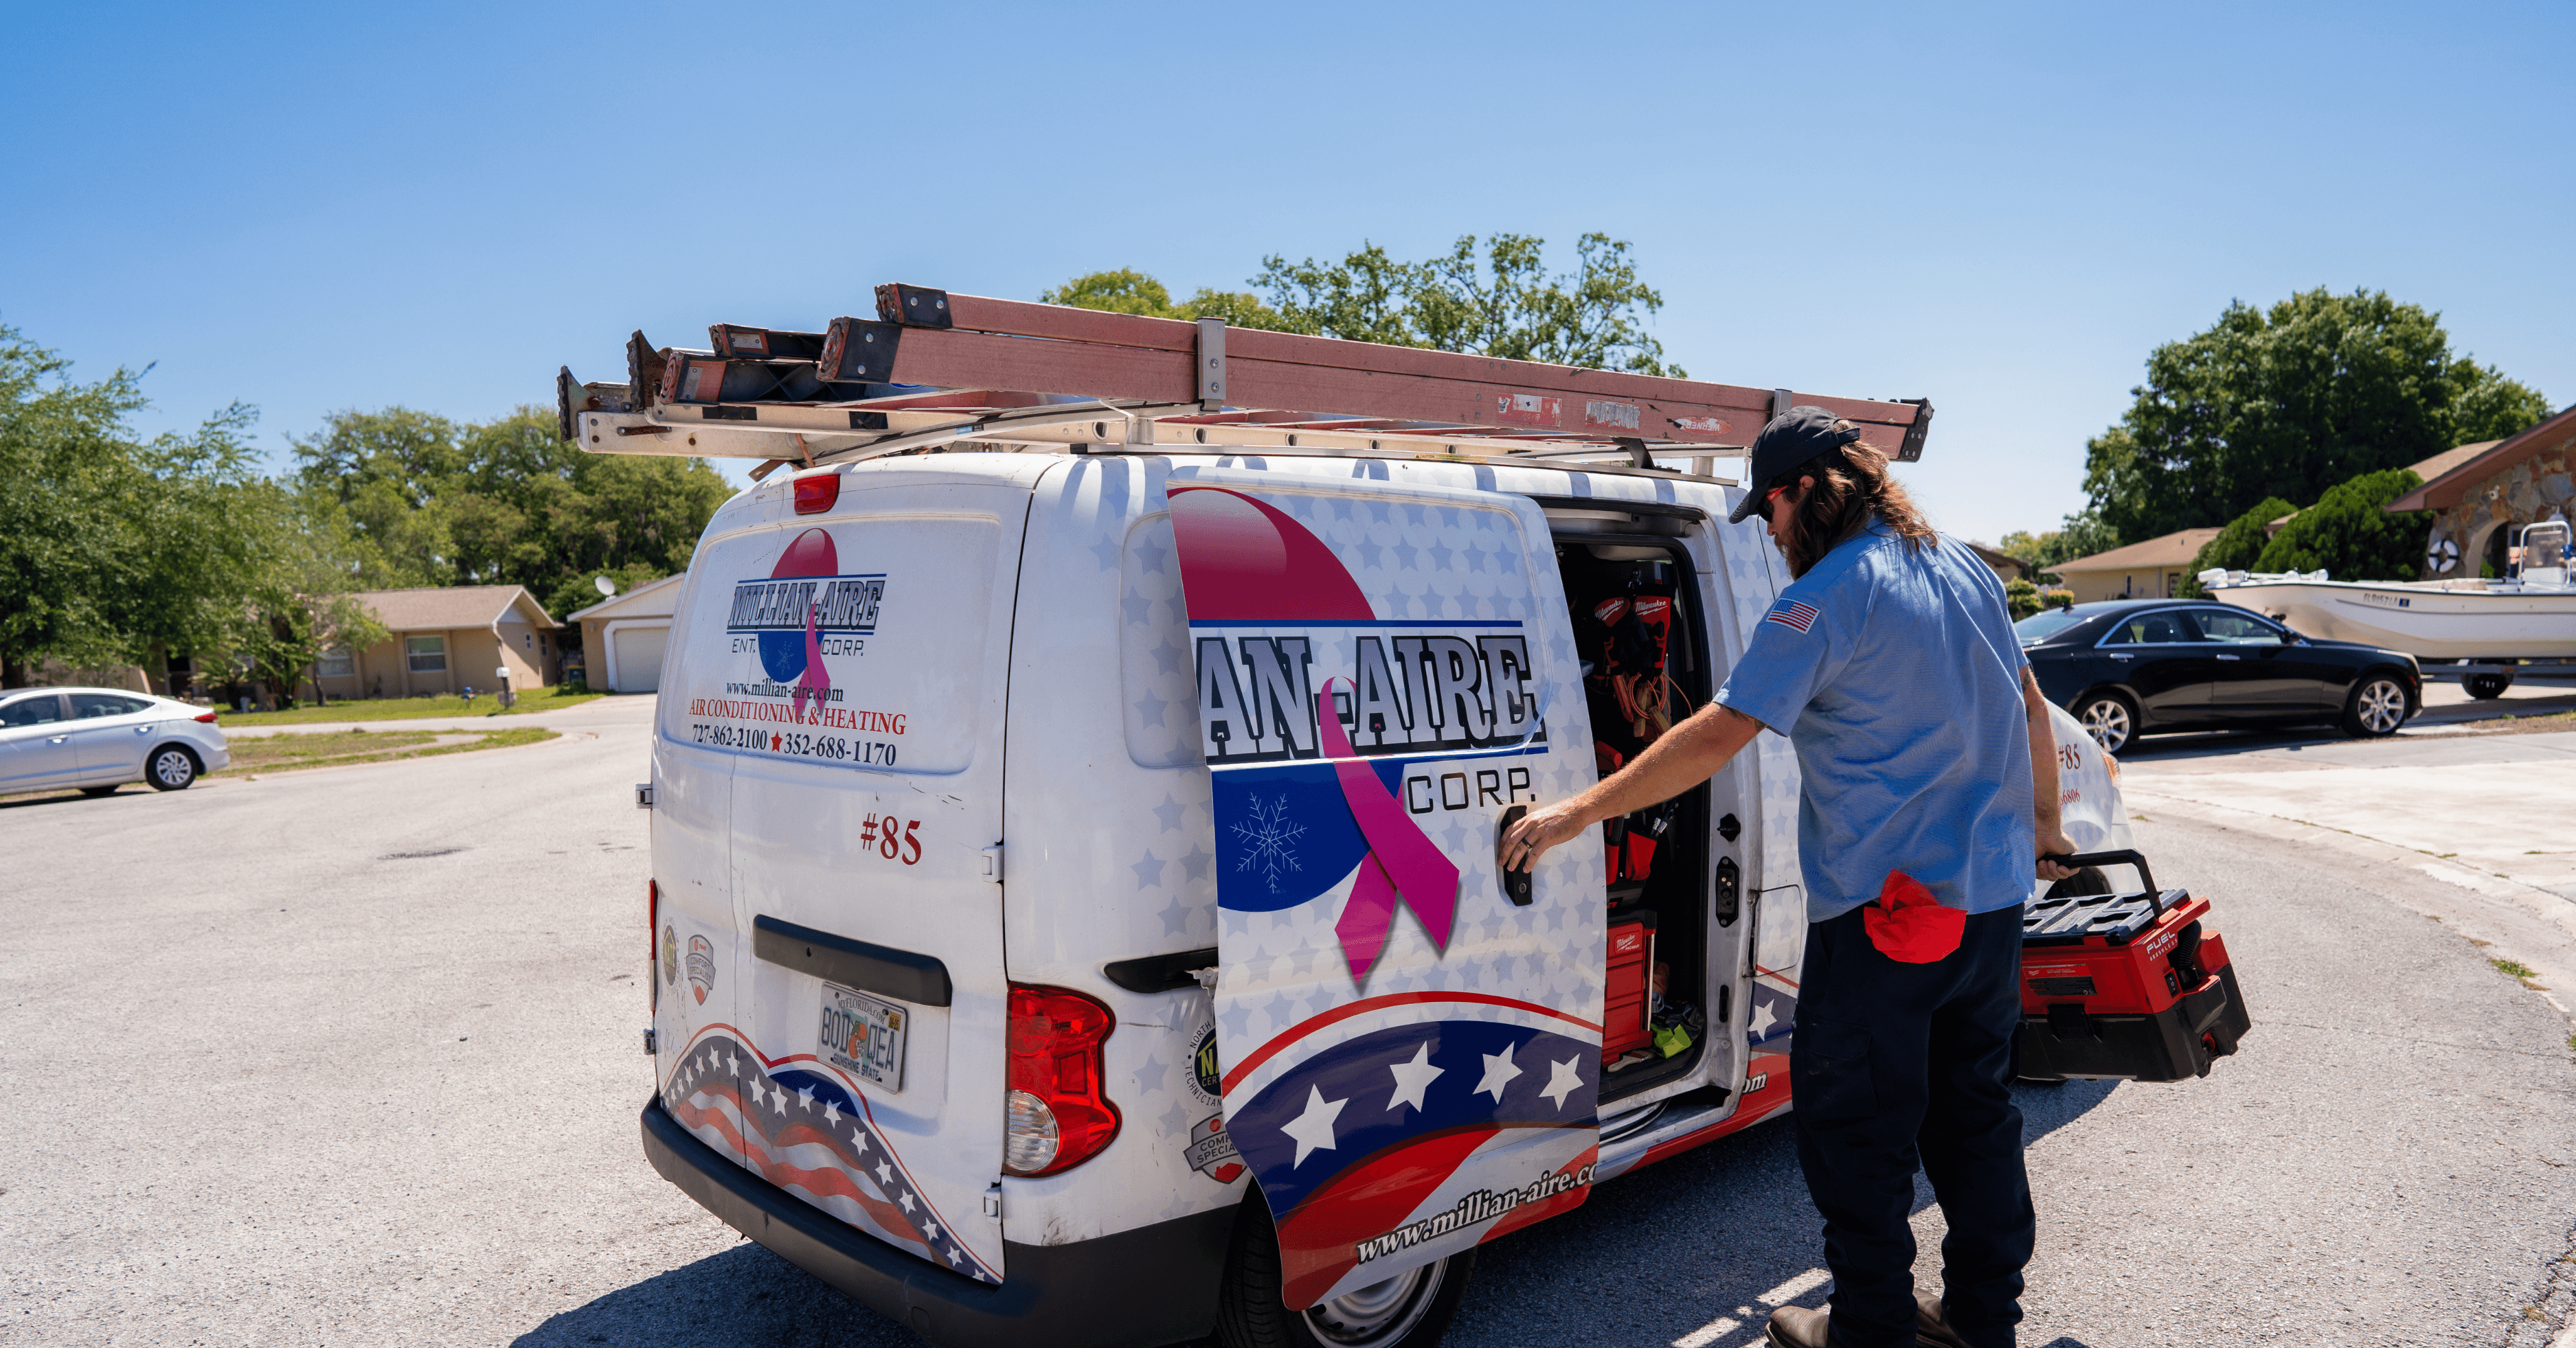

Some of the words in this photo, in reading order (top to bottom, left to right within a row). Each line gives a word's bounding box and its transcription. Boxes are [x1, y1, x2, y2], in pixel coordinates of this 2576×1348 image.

[727, 580, 885, 630] MILLIAN-AIRE
[1635, 599, 1667, 612] Milwaukee
[732, 639, 756, 653] ENT.
[821, 639, 864, 656] CORP.
[726, 678, 844, 702] www.millian-aire.com
[689, 698, 706, 715] AIR
[707, 699, 805, 725] CONDITIONING
[808, 707, 820, 727] &
[823, 707, 907, 735] HEATING
[692, 724, 767, 750] 727-862-2100
[784, 733, 897, 766] 352-688-1170
[2059, 743, 2081, 770] #85
[1407, 767, 1536, 814] CORP.
[860, 812, 921, 865] #85
[2147, 931, 2176, 954] FUEL
[689, 966, 712, 982] SPECIALIST
[690, 957, 710, 972] COMFORT
[867, 1024, 895, 1073] QEA
[1189, 1020, 1212, 1049] NORTH
[833, 1053, 860, 1074] SUNSHINE
[861, 1064, 881, 1082] STATE
